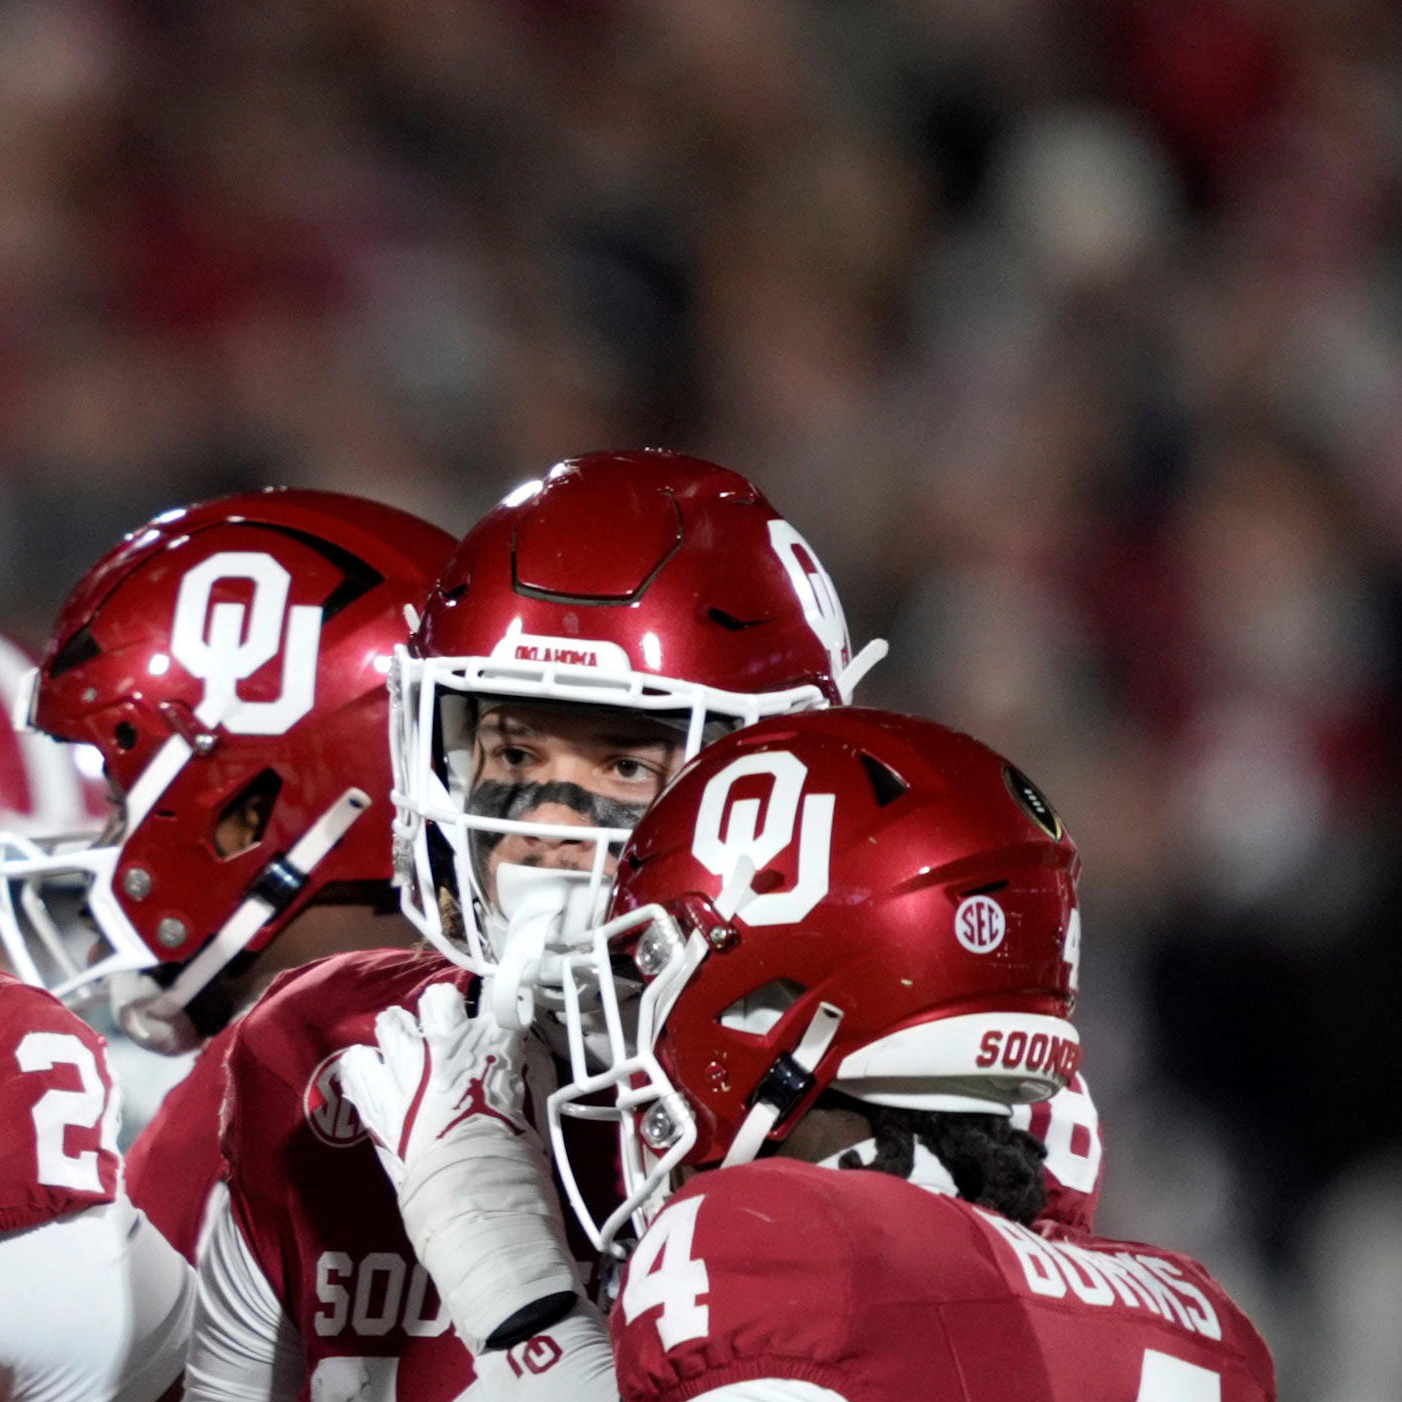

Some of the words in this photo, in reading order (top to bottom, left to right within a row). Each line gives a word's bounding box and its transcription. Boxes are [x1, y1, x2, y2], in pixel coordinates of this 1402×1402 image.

[171, 551, 324, 735] OU
[692, 750, 836, 927] OU
[962, 902, 1000, 947] SEC
[622, 1193, 710, 1353] 4
